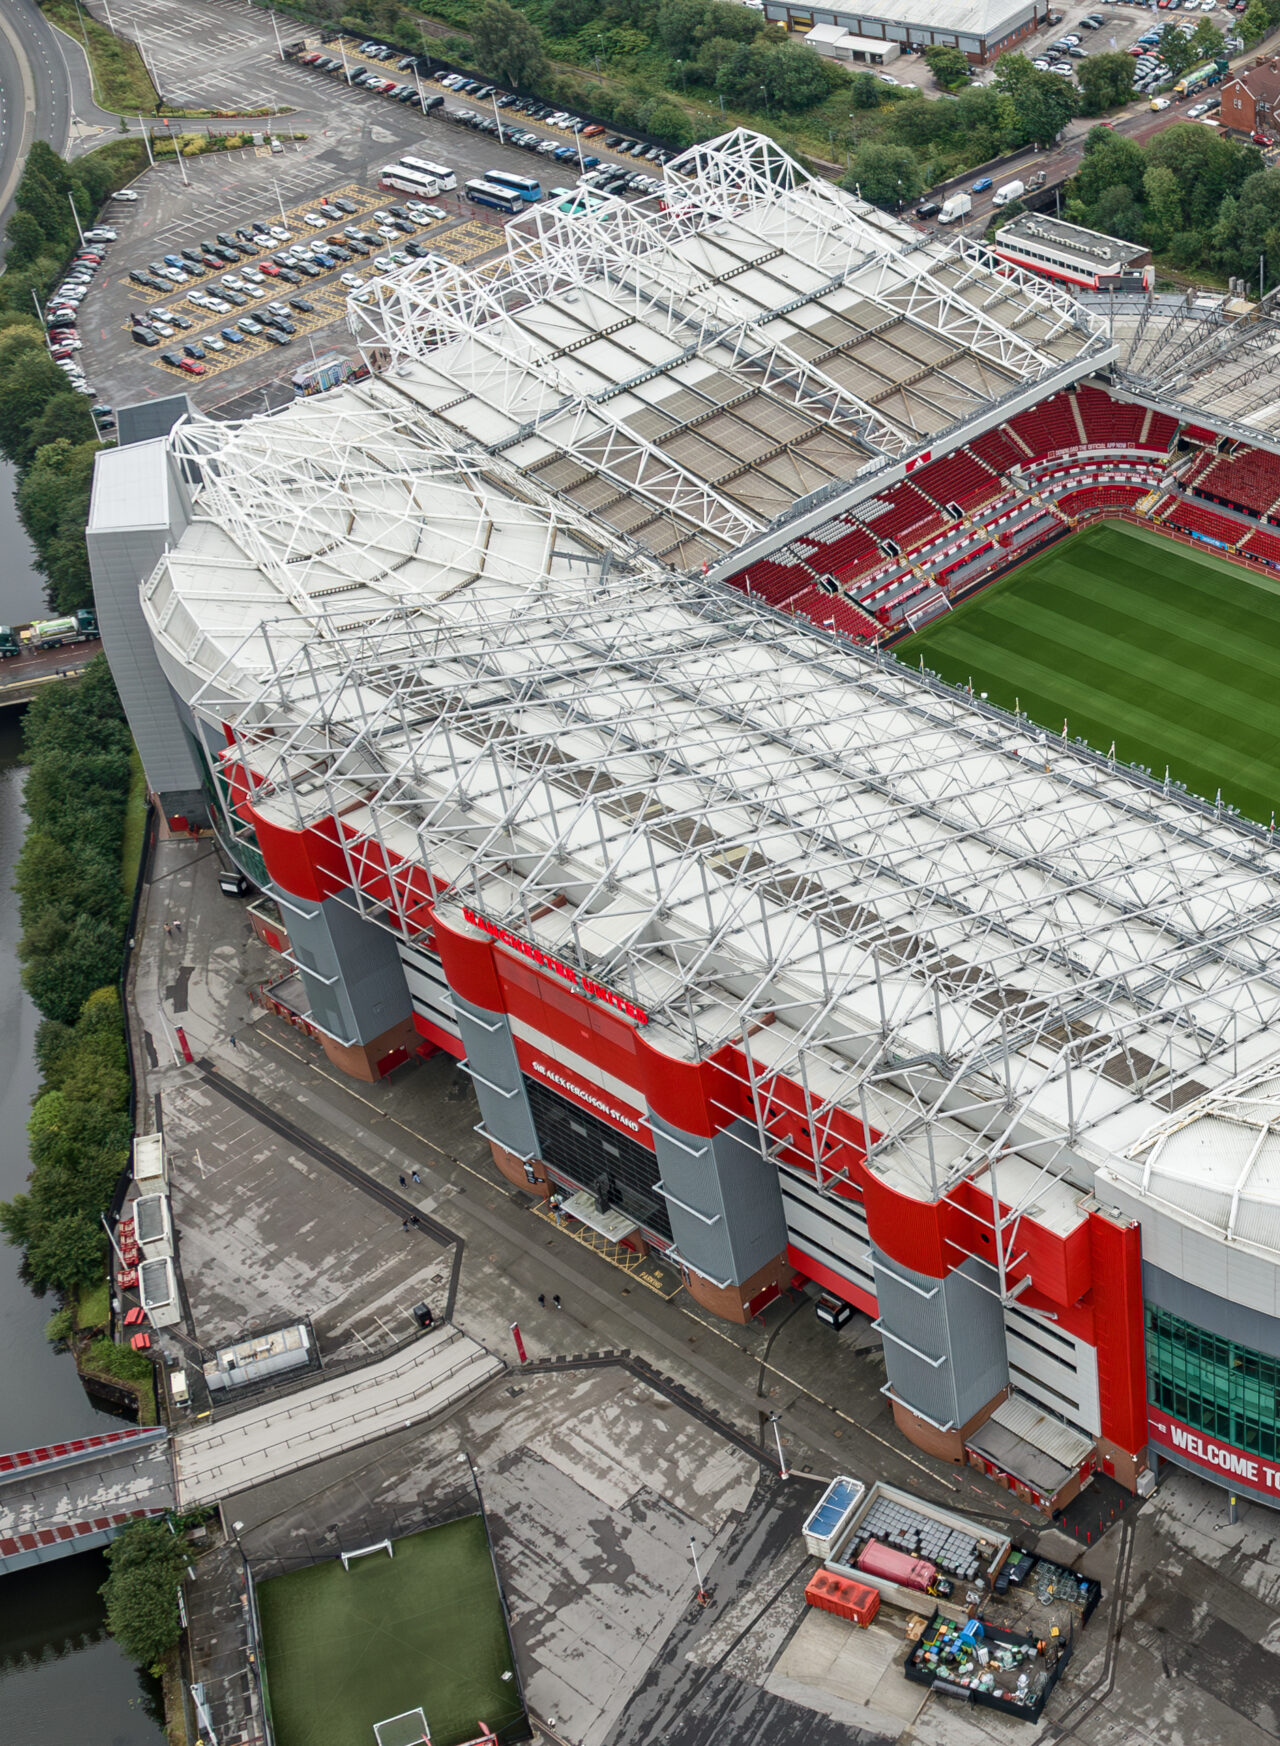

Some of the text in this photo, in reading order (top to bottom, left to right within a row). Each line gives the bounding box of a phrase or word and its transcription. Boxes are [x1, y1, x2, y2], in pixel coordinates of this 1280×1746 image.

[461, 906, 648, 1025] MANCHESTER UNITED
[532, 1061, 639, 1132] SIR ALEX FERGUSON STAND
[653, 1270, 664, 1279] NO
[1170, 1424, 1259, 1482] WELCOME
